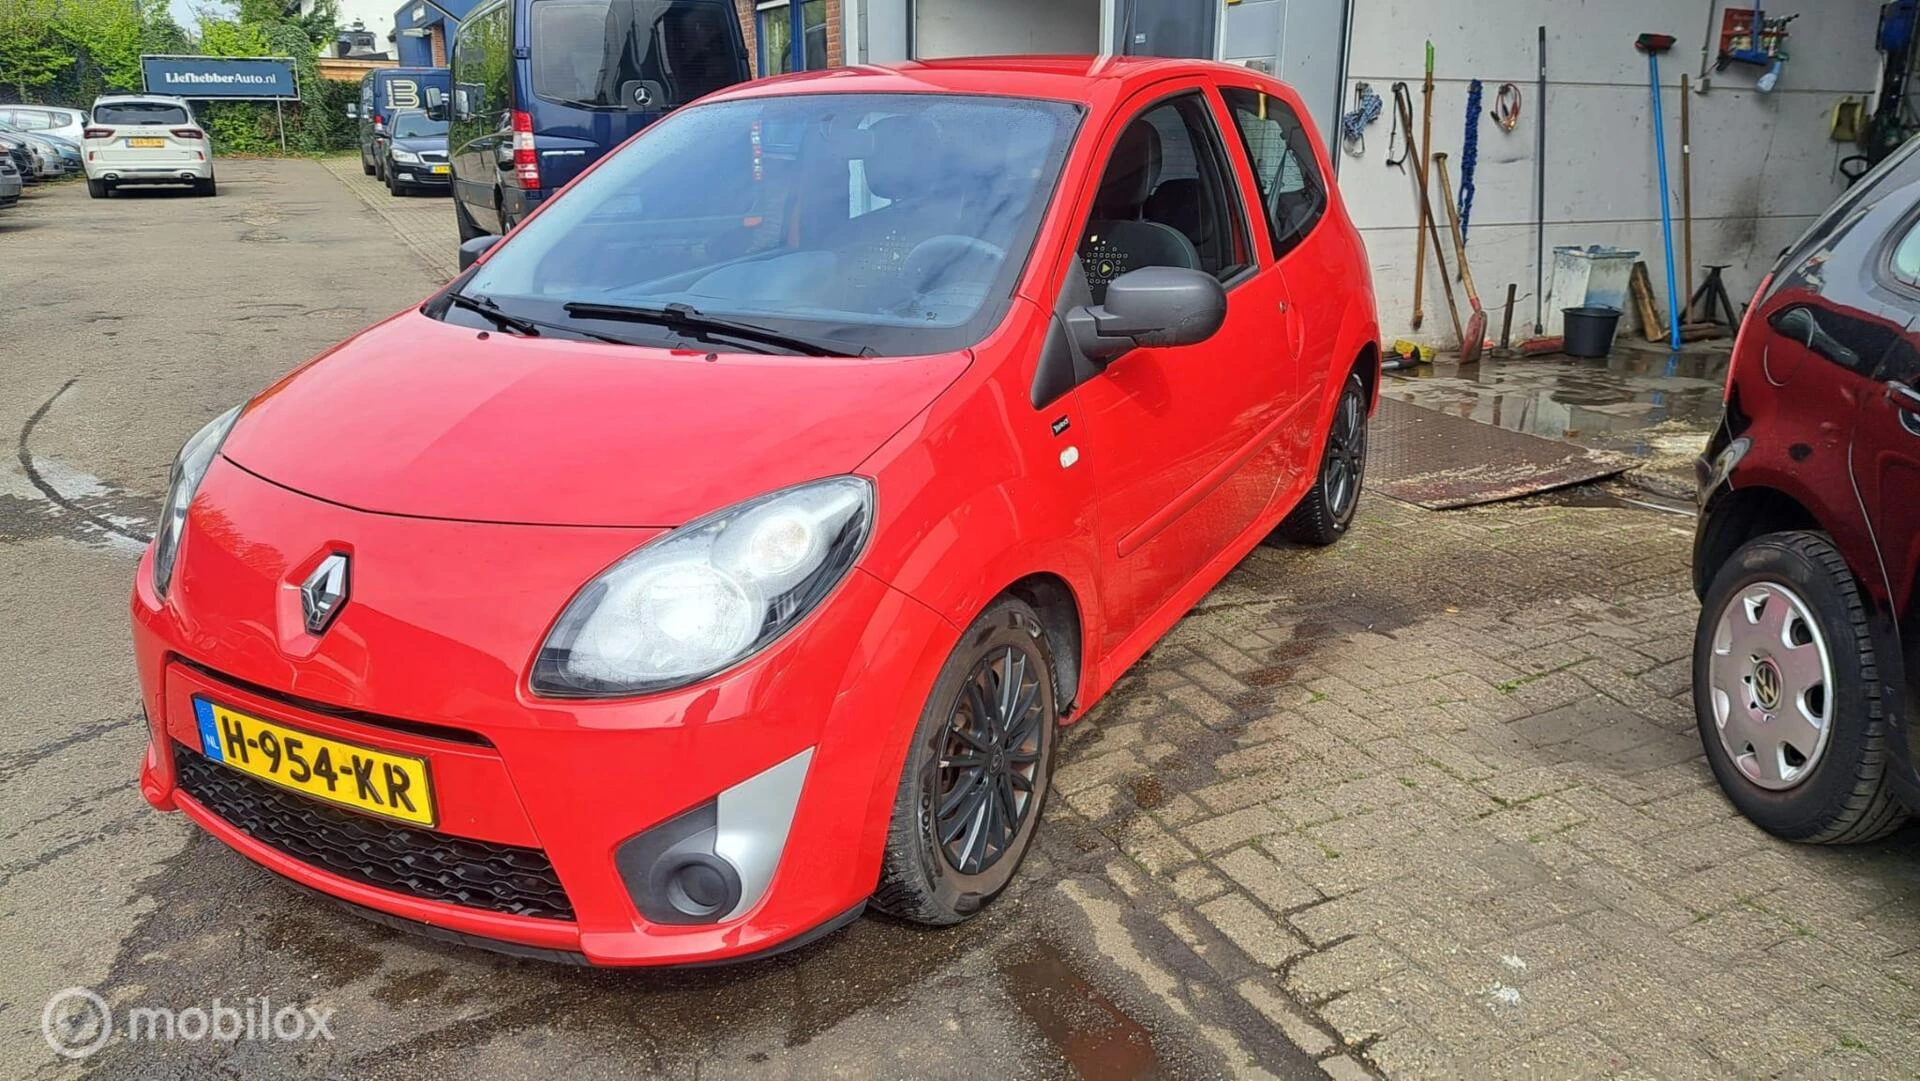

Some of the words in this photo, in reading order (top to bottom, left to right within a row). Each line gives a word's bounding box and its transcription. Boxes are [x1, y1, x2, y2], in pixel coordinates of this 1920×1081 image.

[165, 72, 276, 84] LiefhebberAuto.nl
[204, 733, 220, 750] NL
[221, 715, 417, 813] H-954-KR
